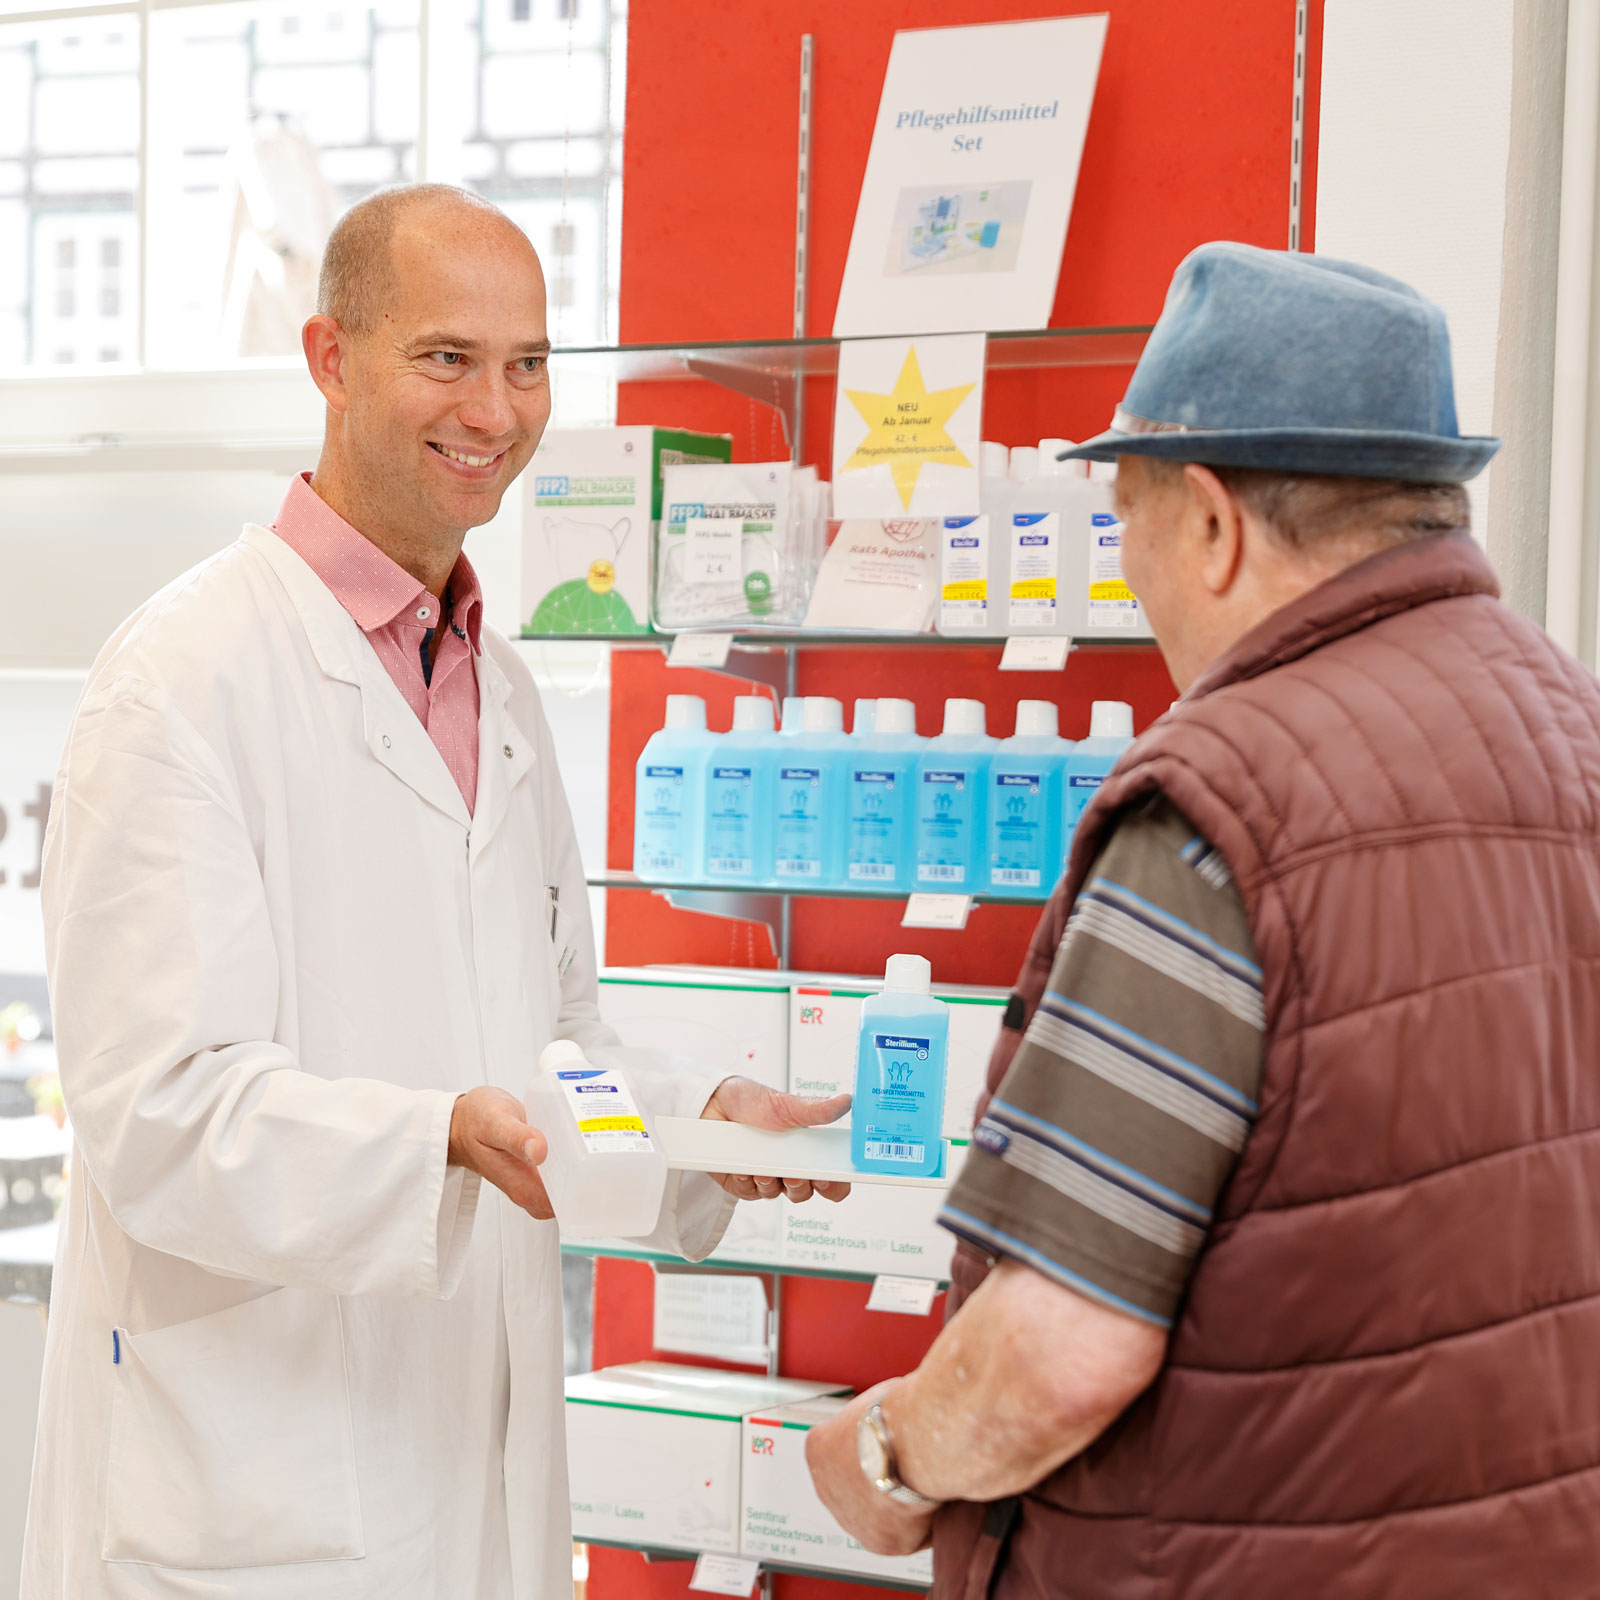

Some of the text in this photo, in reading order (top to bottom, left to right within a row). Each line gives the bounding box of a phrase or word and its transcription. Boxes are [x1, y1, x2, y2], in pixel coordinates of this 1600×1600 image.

[896, 100, 1059, 132] Pflegehilfsmittel
[952, 134, 983, 152] Set
[897, 402, 919, 412] NEU
[882, 416, 932, 426] Ab Januar
[536, 477, 635, 494] FFP2 HALBMASKE
[669, 504, 776, 523] FFP2 HALBMASKE
[849, 544, 878, 553] Rats
[872, 1088, 925, 1098] DESINFEKTIONSMITTEL
[889, 1082, 909, 1090] HÄNDE-
[787, 1215, 829, 1231] Sentina
[787, 1231, 867, 1249] Ambidextrous
[890, 1240, 924, 1254] Latex
[614, 1504, 645, 1519] Latex
[746, 1506, 787, 1524] Sentina
[745, 1522, 824, 1544] Ambidextrous
